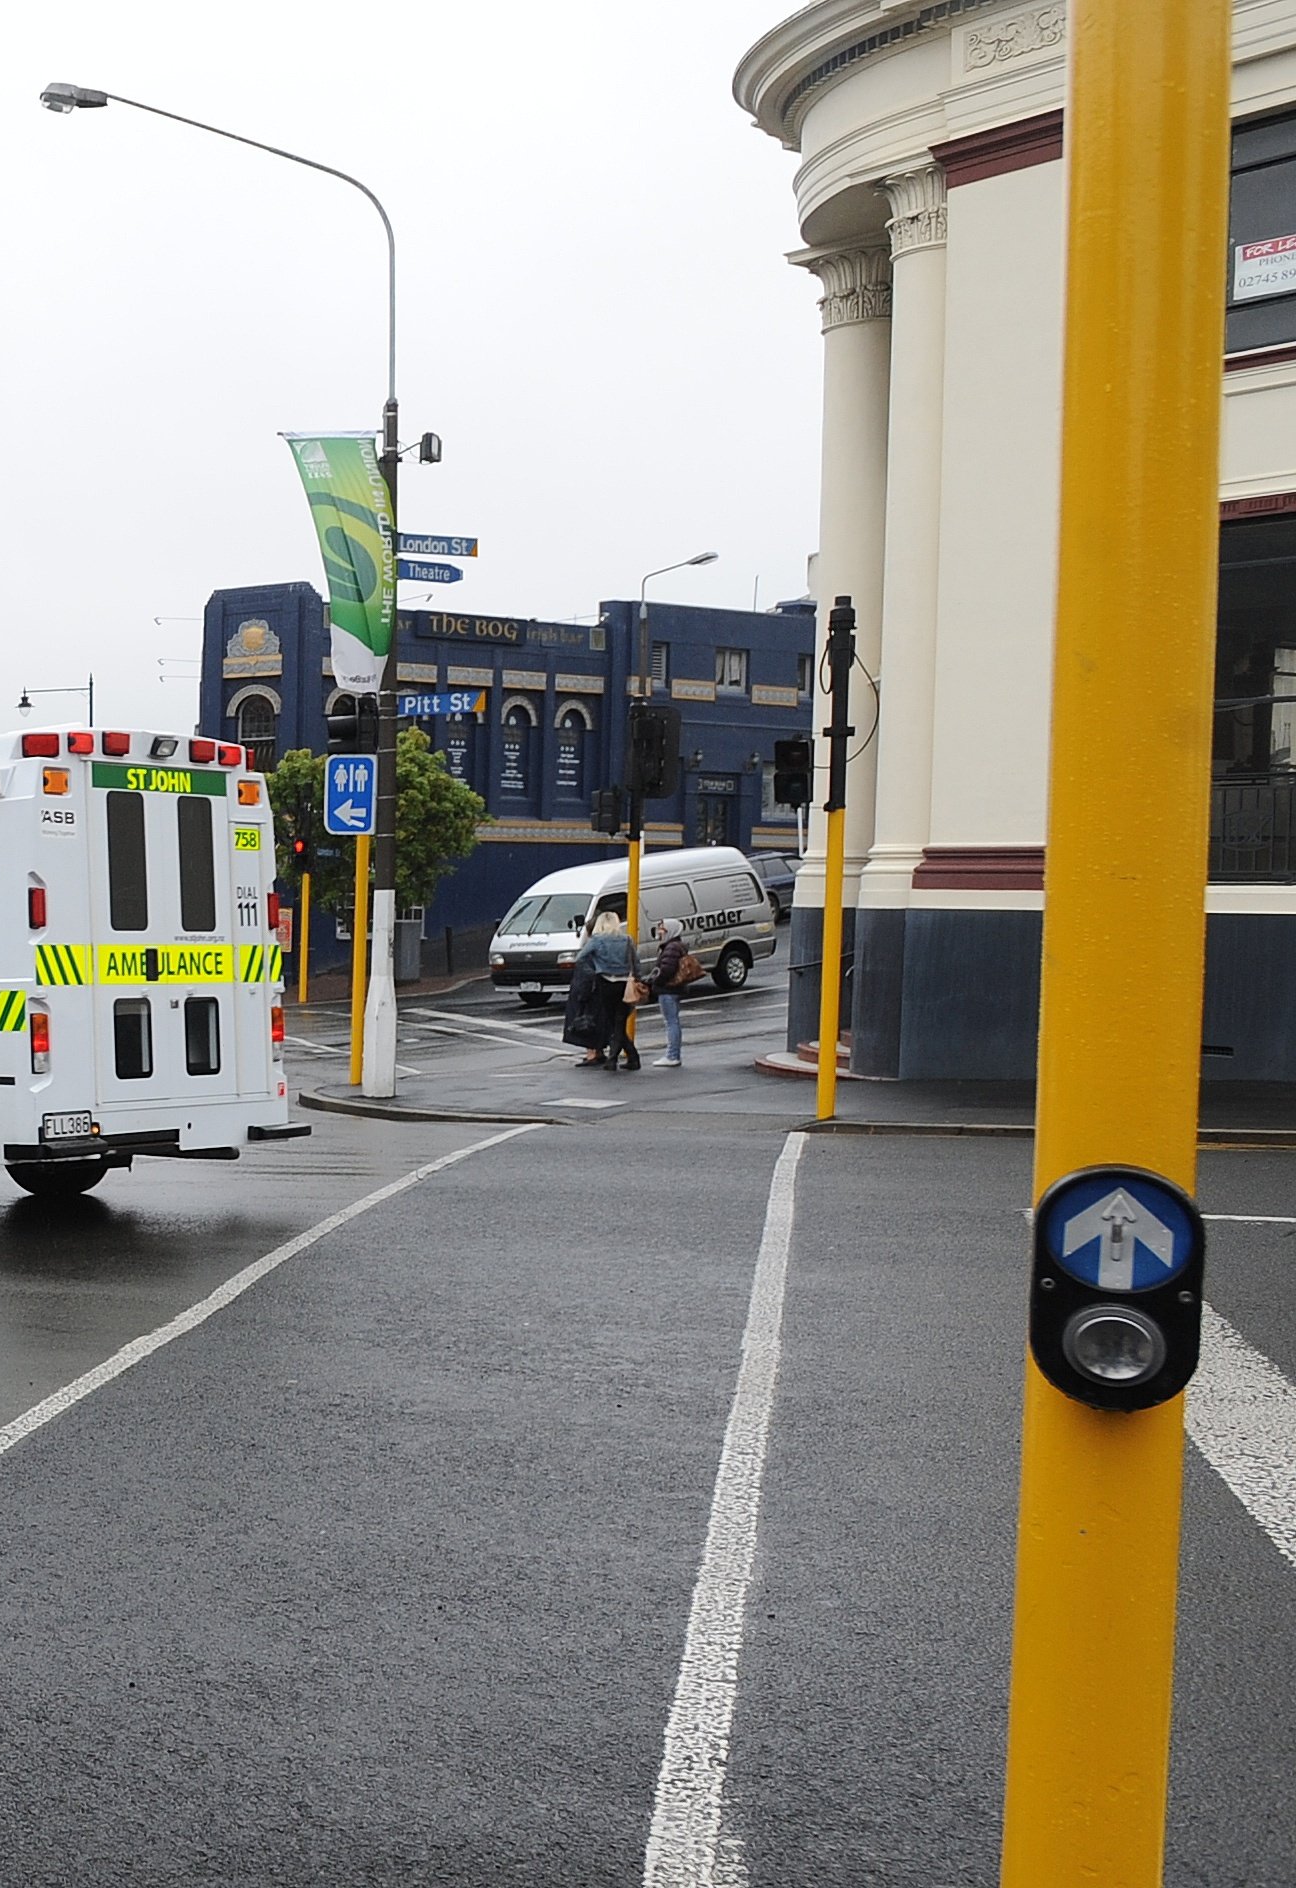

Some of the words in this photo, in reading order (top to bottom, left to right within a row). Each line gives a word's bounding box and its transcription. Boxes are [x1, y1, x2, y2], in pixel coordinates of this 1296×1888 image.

[1245, 244, 1274, 257] FOR
[1239, 272, 1278, 288] 02745
[399, 536, 448, 554] London
[451, 538, 469, 555] St
[408, 562, 451, 581] Theatre
[430, 614, 470, 635] THE
[475, 620, 519, 641] BOG
[404, 695, 441, 714] Pitt
[450, 693, 471, 711] St
[127, 769, 147, 790] ST
[149, 770, 192, 793] JOHN
[41, 810, 75, 824] ASB
[235, 831, 257, 848] 758
[237, 886, 258, 899] DIAL
[237, 902, 258, 927] 111
[45, 1115, 89, 1136] FLL386
